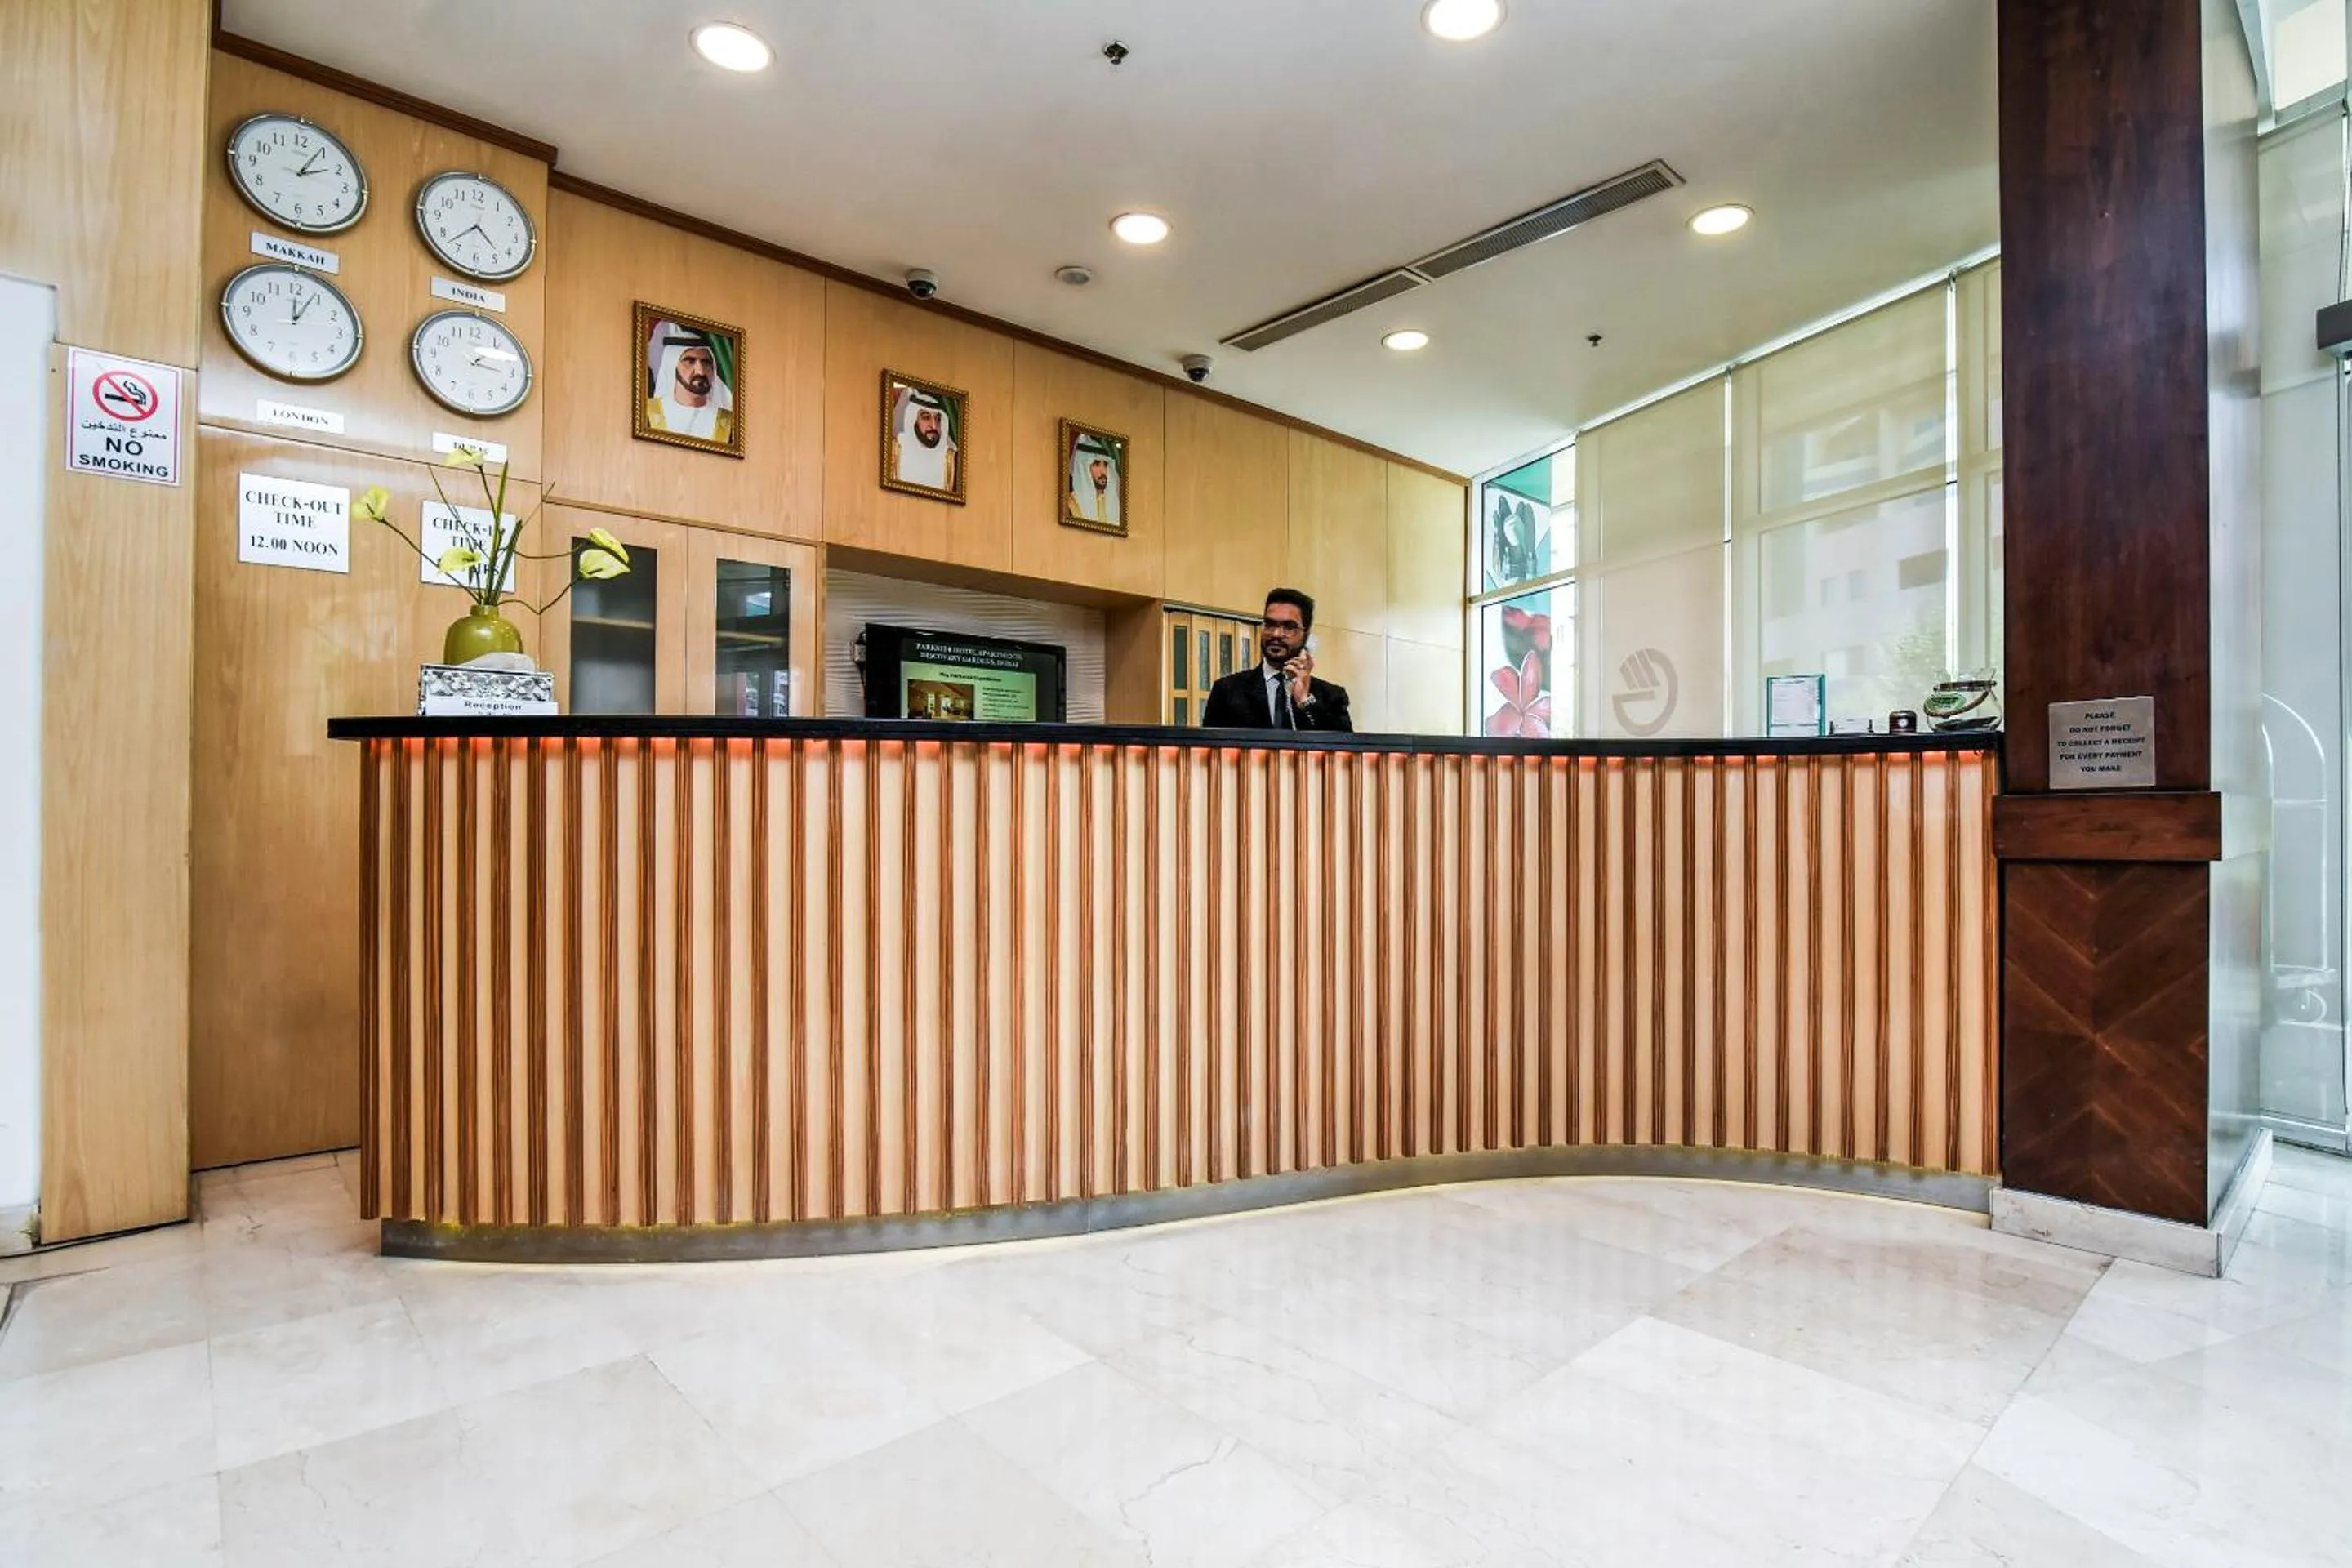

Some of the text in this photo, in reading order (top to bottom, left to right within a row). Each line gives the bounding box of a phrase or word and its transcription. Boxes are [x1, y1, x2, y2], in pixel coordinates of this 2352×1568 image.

[273, 131, 285, 147] 11
[294, 133, 308, 149] 12
[256, 140, 271, 156] 10
[441, 196, 454, 209] 10
[454, 188, 466, 202] 11
[471, 189, 484, 203] 12
[265, 242, 325, 265] MAKKAH
[268, 282, 280, 296] 11
[289, 283, 302, 296] 12
[452, 287, 485, 303] INDIA
[250, 291, 266, 305] 10
[451, 326, 462, 338] 11
[470, 327, 481, 339] 12
[437, 335, 449, 347] 10
[272, 408, 329, 425] LONDON
[105, 437, 144, 456] NO
[78, 454, 169, 478] SMOKING
[245, 490, 343, 514] CHECK-OUT
[274, 512, 317, 528] TIME
[432, 516, 496, 538] CHECK-I
[251, 535, 340, 555] 12.00 NOON
[464, 701, 522, 710] Reception
[2085, 711, 2115, 719] PLEASE
[2105, 751, 2142, 759] PAYMENT
